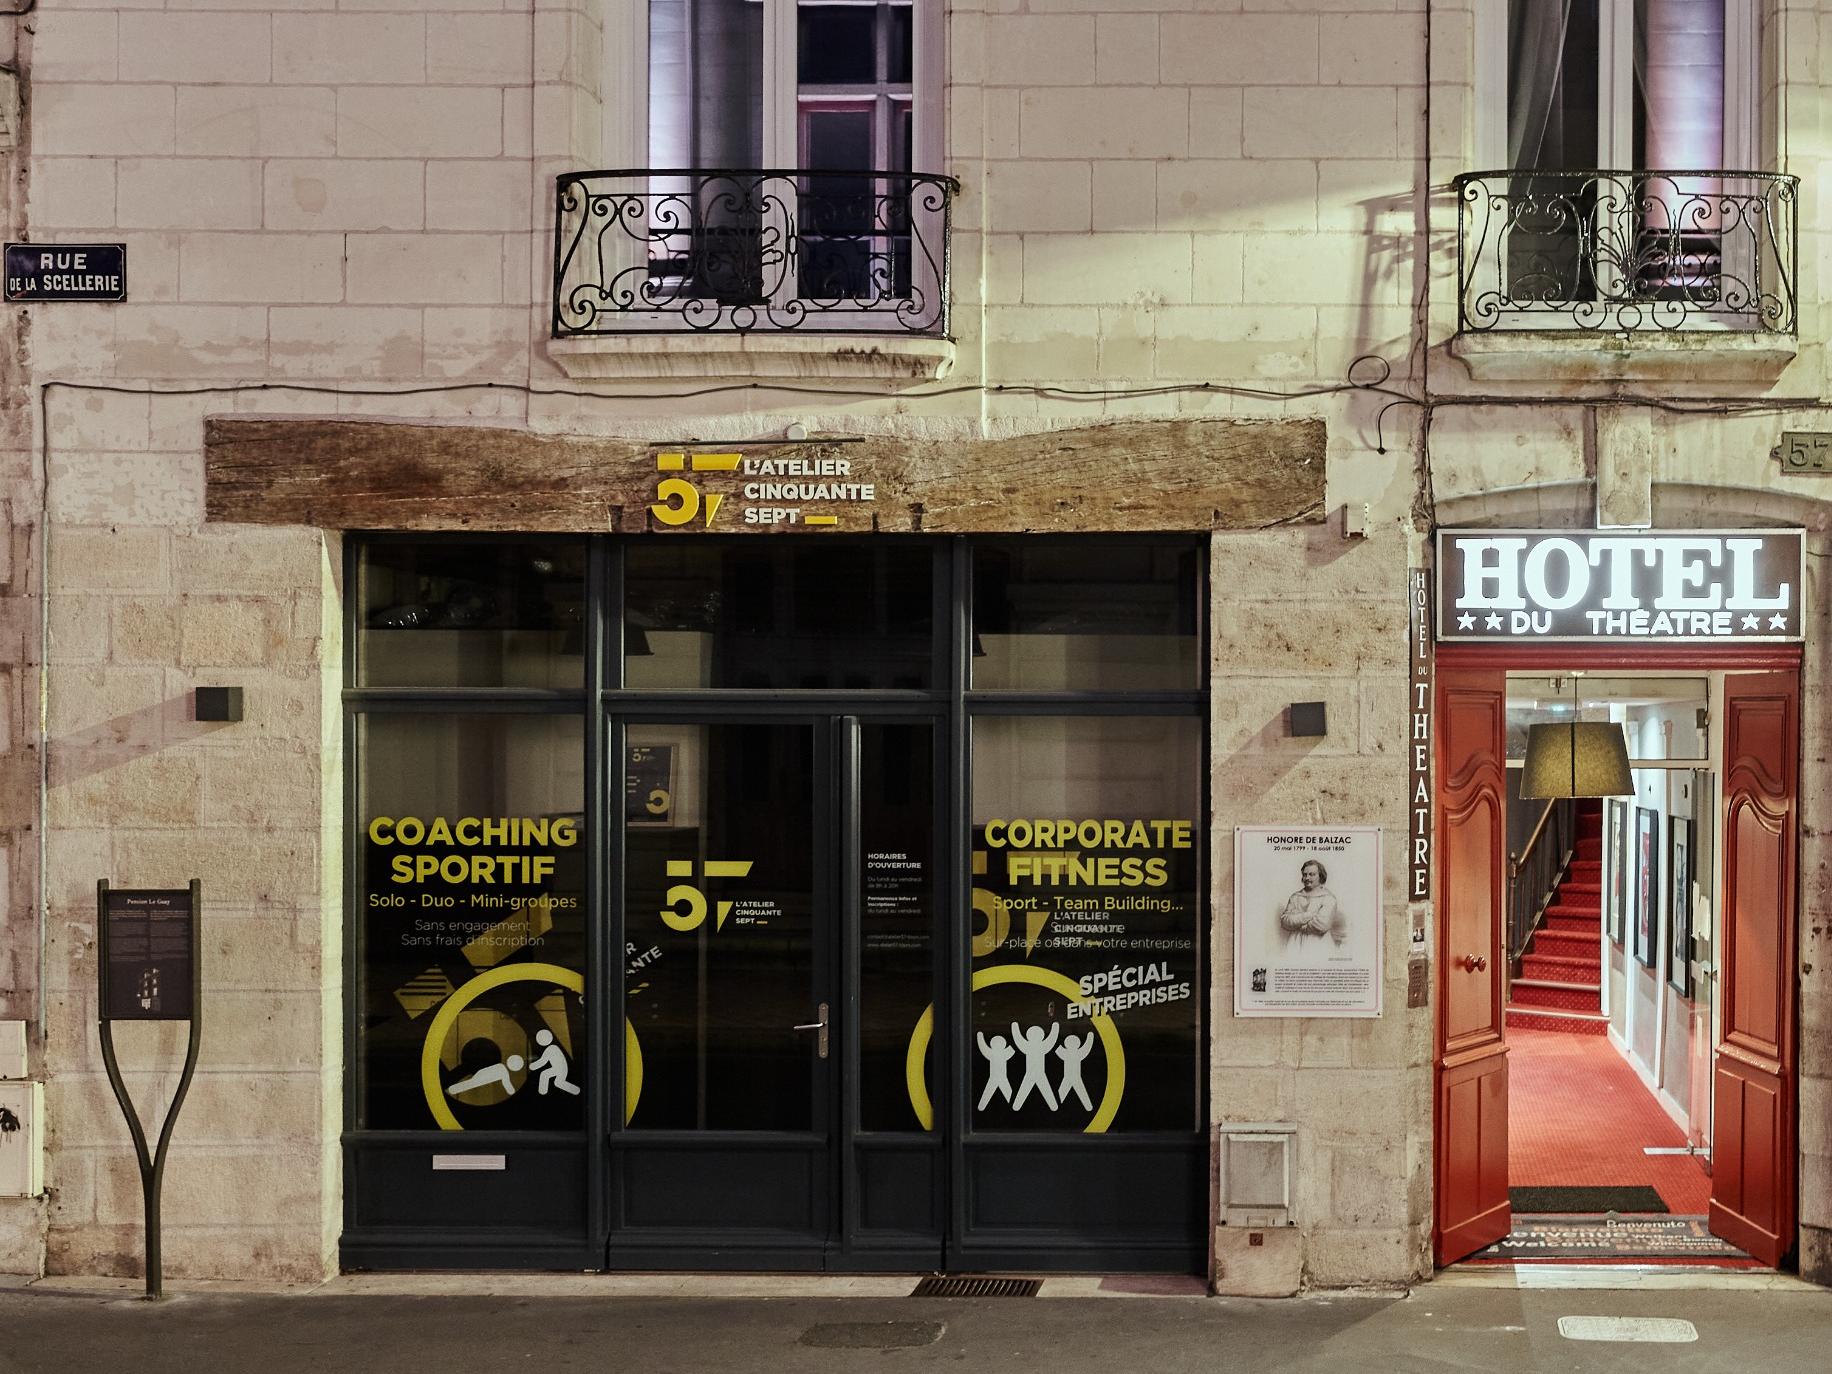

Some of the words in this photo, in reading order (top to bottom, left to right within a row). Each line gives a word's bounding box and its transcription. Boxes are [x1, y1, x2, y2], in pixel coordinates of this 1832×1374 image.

[40, 253, 88, 270] RUE
[9, 277, 21, 291] DE
[25, 277, 37, 291] LA
[43, 274, 120, 291] SCELLERIE
[1789, 438, 1829, 467] 57
[744, 459, 851, 476] L'ATELIER
[651, 453, 743, 529] 57
[744, 483, 875, 500] CINQUANTE
[744, 508, 801, 524] SEPT
[1455, 537, 1790, 610] HOTEL
[1416, 572, 1427, 660] HOTEL
[1511, 611, 1553, 634] DU
[1586, 608, 1734, 635] THÉATRE
[1418, 666, 1428, 676] DU
[1413, 682, 1429, 896] THEATRE
[369, 816, 578, 847] COACHING
[985, 819, 1192, 849] CORPORATE
[1266, 836, 1303, 844] HONORE
[1305, 836, 1316, 844] DE
[1319, 836, 1352, 844] BALZAC
[391, 855, 556, 884] SPORTIF
[1009, 857, 1169, 886] FITNESS
[369, 893, 405, 908] Solo
[421, 894, 456, 908] Duo
[471, 893, 578, 911] Mini-groupes
[659, 860, 754, 934] 57
[992, 896, 1038, 912] Sport
[1054, 896, 1099, 910] Team
[735, 909, 783, 917] CINQUANTE
[414, 919, 446, 931] Sans
[448, 920, 531, 934] engagement
[401, 933, 432, 945] Sans
[435, 933, 463, 945] frais
[1131, 937, 1191, 950] entreprise
[1079, 961, 1175, 997] SPÉCIAL
[1066, 982, 1191, 1020] ENTREPRISES
